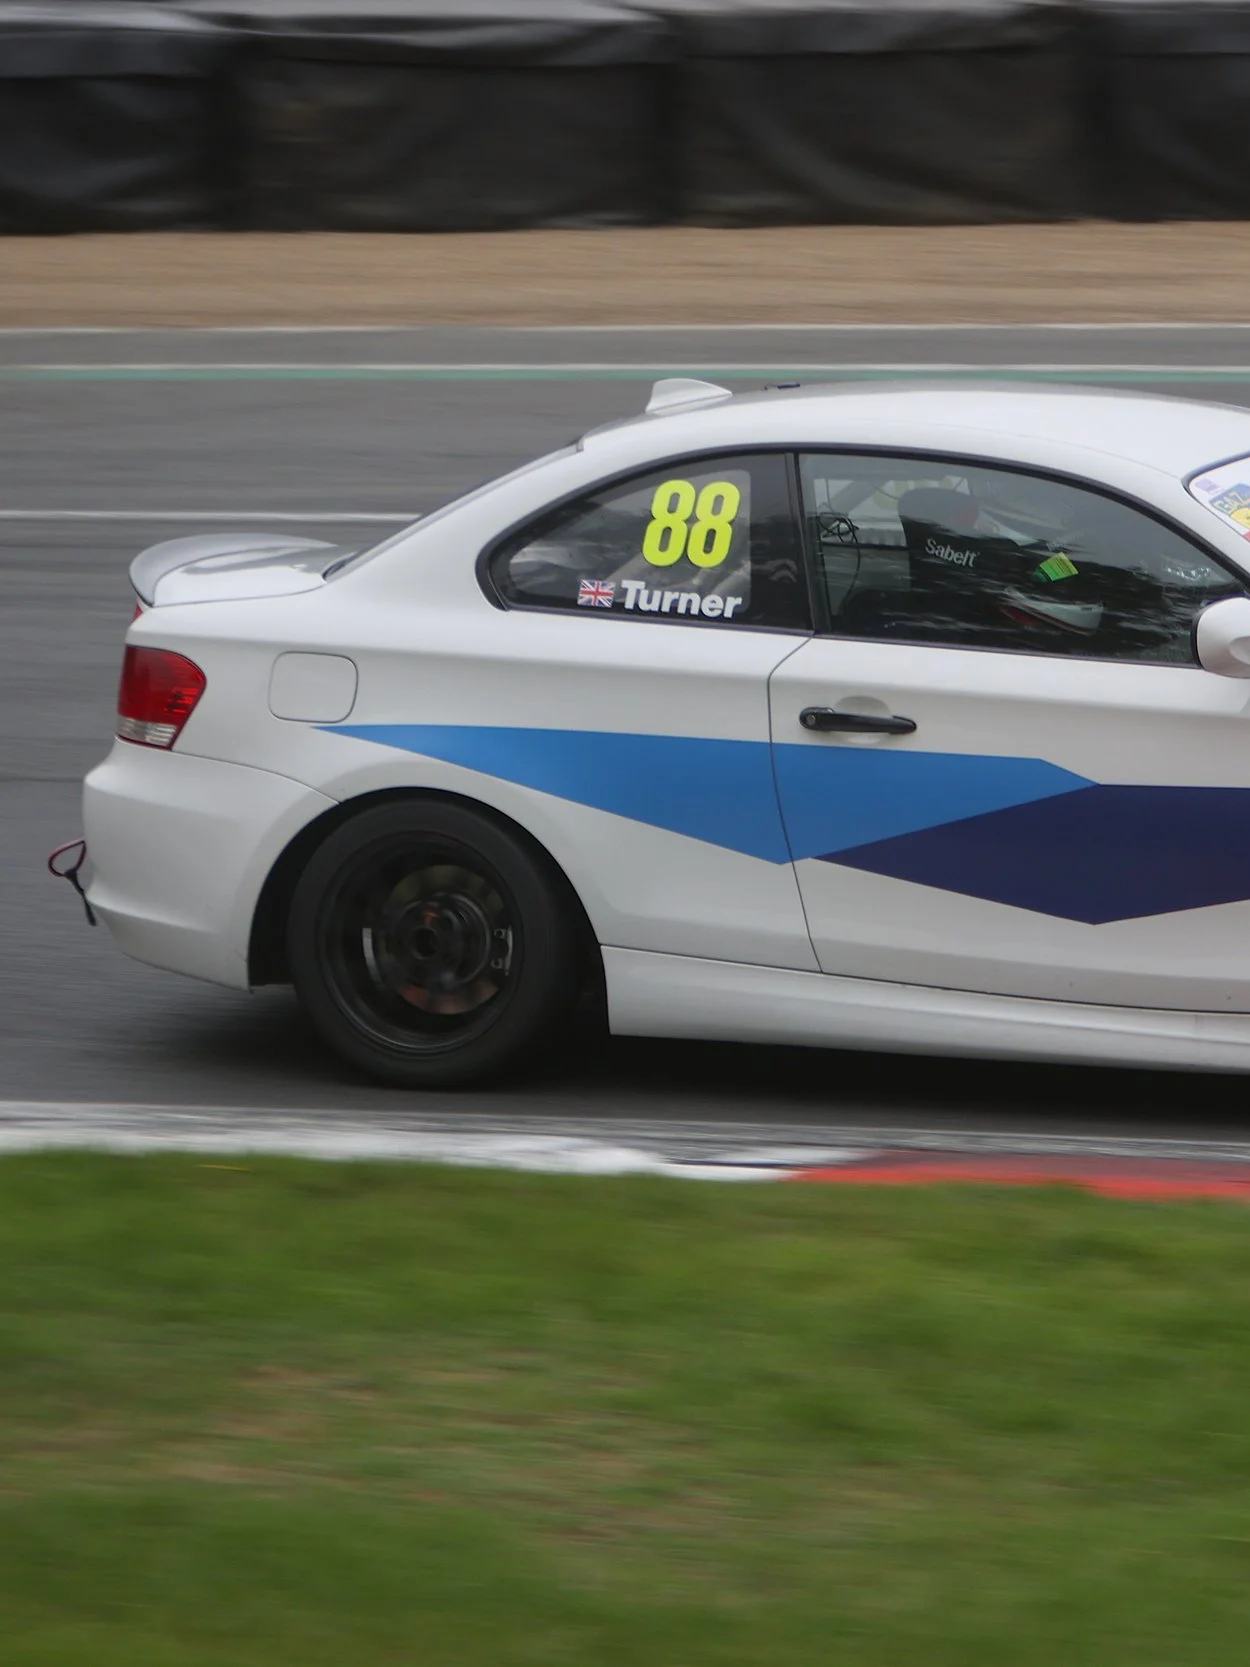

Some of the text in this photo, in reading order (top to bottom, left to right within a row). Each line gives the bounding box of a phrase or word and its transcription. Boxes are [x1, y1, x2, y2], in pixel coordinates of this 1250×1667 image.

[642, 479, 741, 568] 88
[925, 538, 977, 568] Sabelt
[621, 579, 743, 619] Turner
